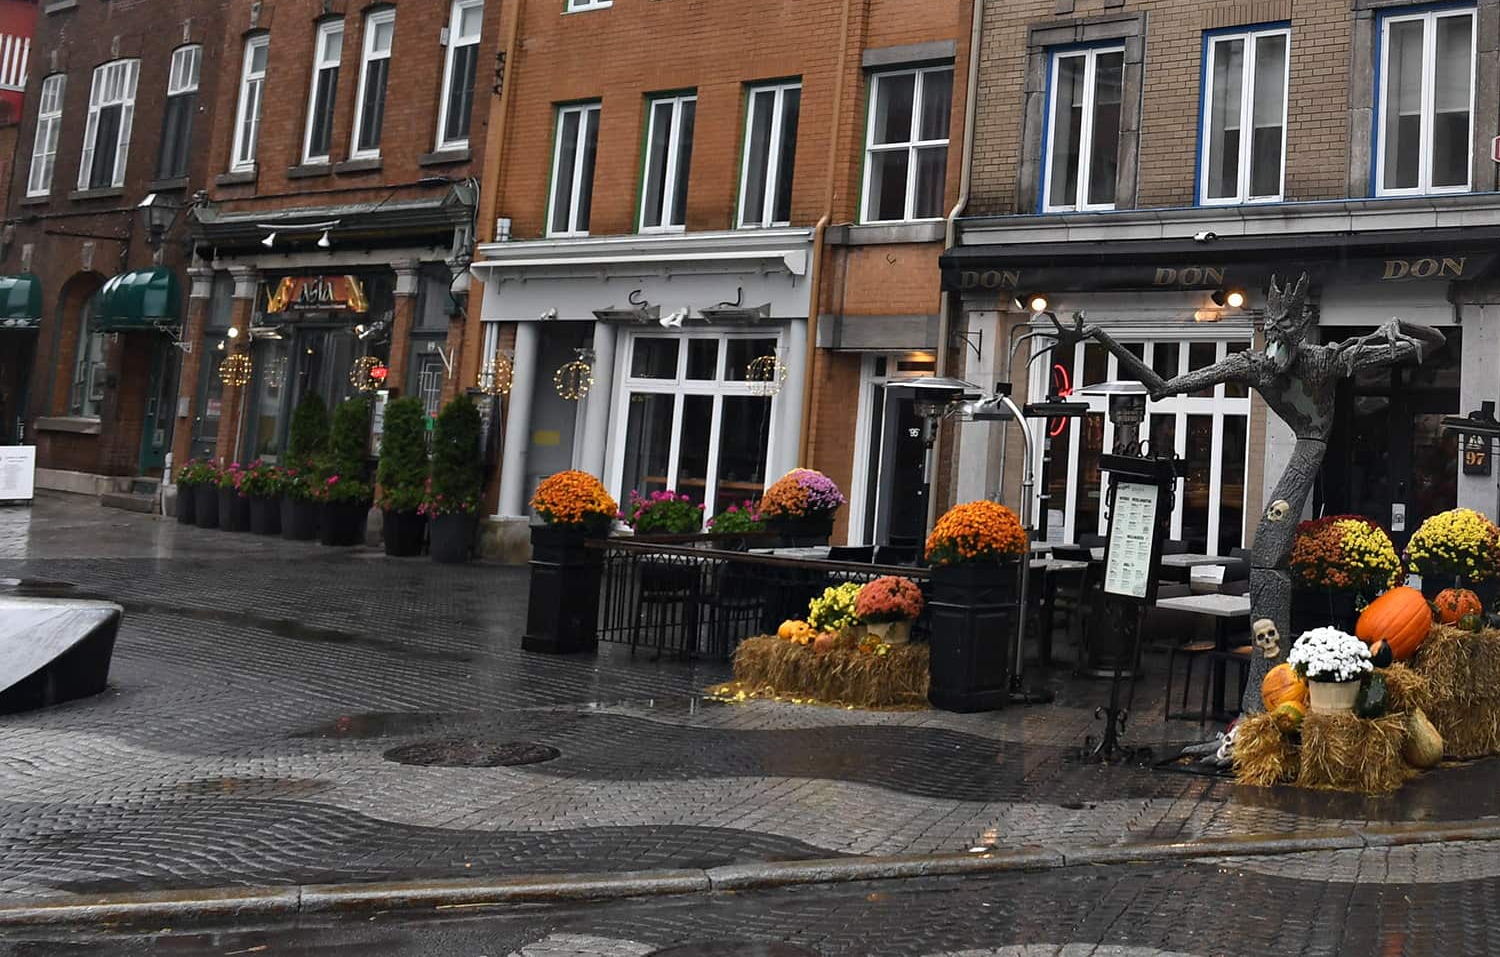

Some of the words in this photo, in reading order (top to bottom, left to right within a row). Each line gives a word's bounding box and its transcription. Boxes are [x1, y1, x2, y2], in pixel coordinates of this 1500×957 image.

[1152, 266, 1227, 286] DON
[1381, 257, 1467, 280] DON
[960, 270, 1021, 289] DON
[1465, 451, 1486, 466] 97
